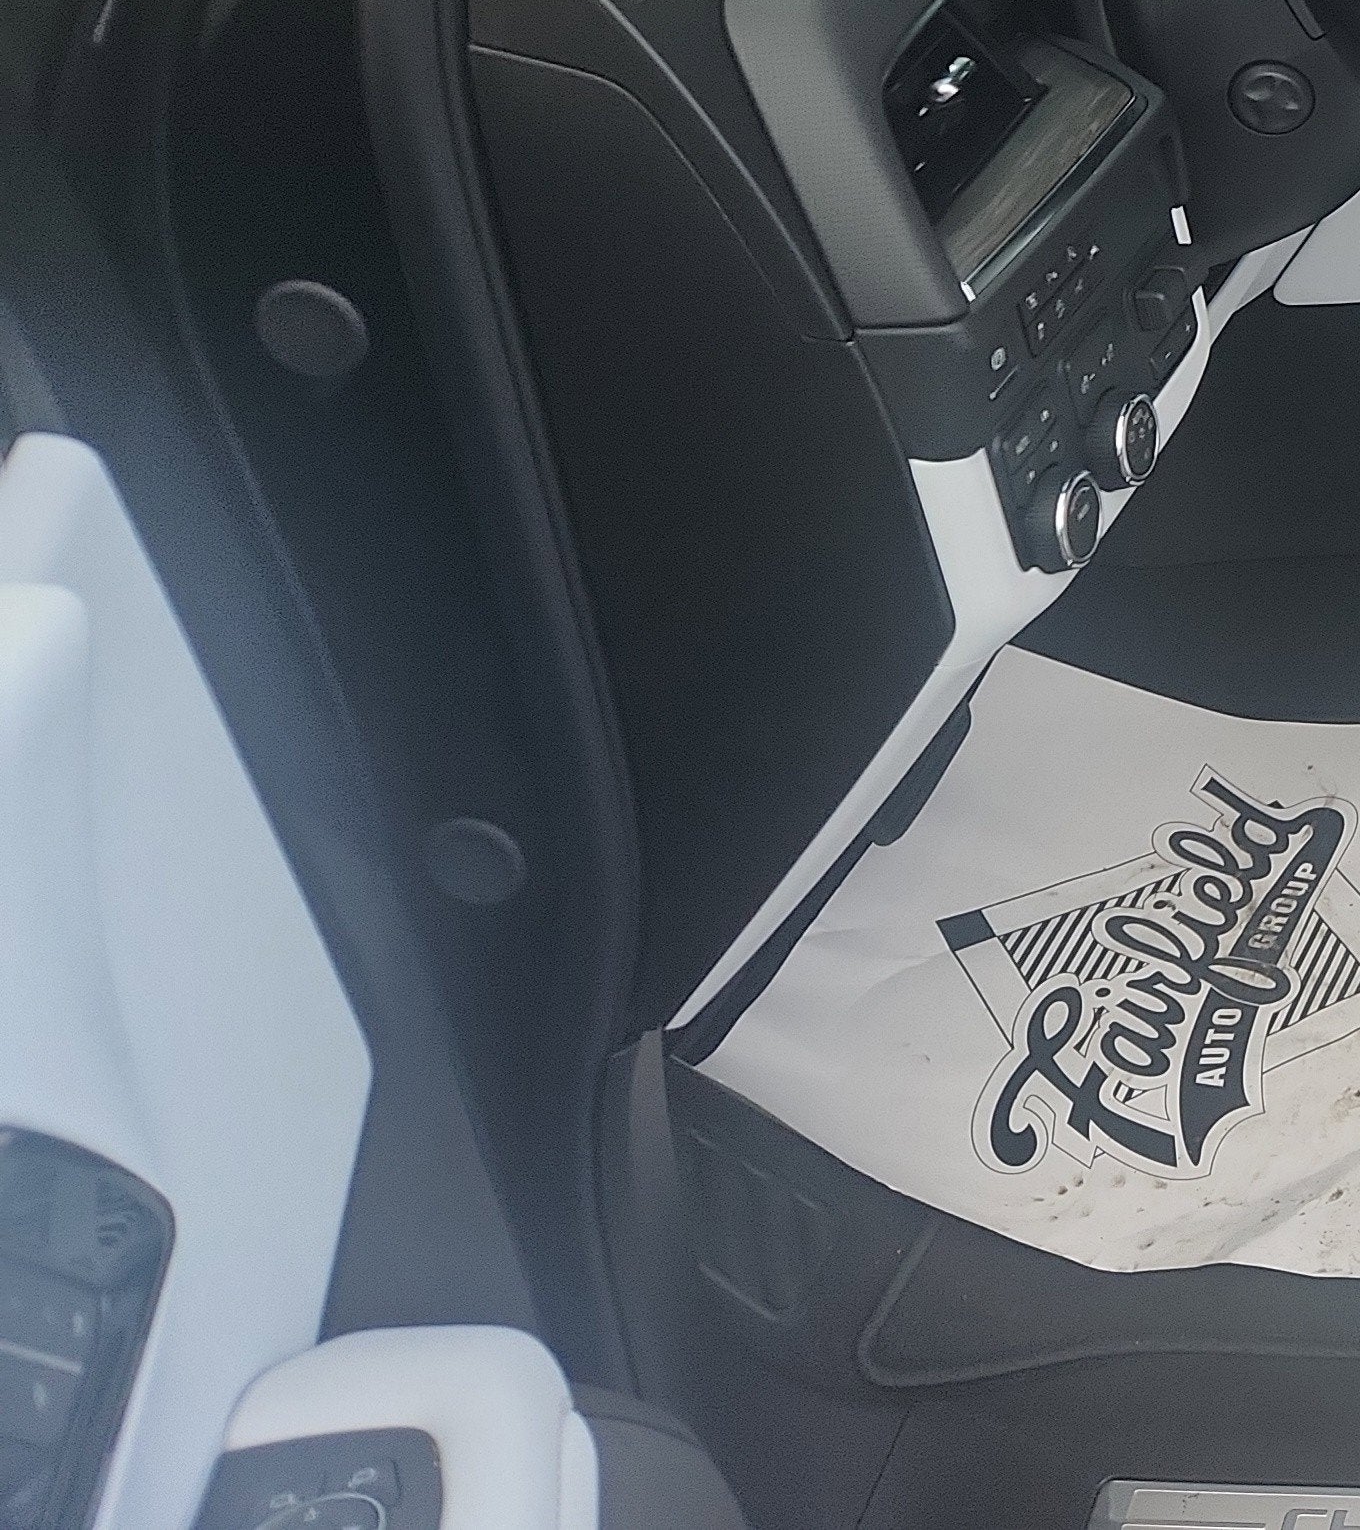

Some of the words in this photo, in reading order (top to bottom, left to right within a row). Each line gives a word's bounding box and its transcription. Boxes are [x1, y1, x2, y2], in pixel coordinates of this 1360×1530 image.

[990, 776, 1297, 1168] Fairfield
[1194, 1006, 1244, 1088] AUTO
[1247, 862, 1319, 950] GROUP
